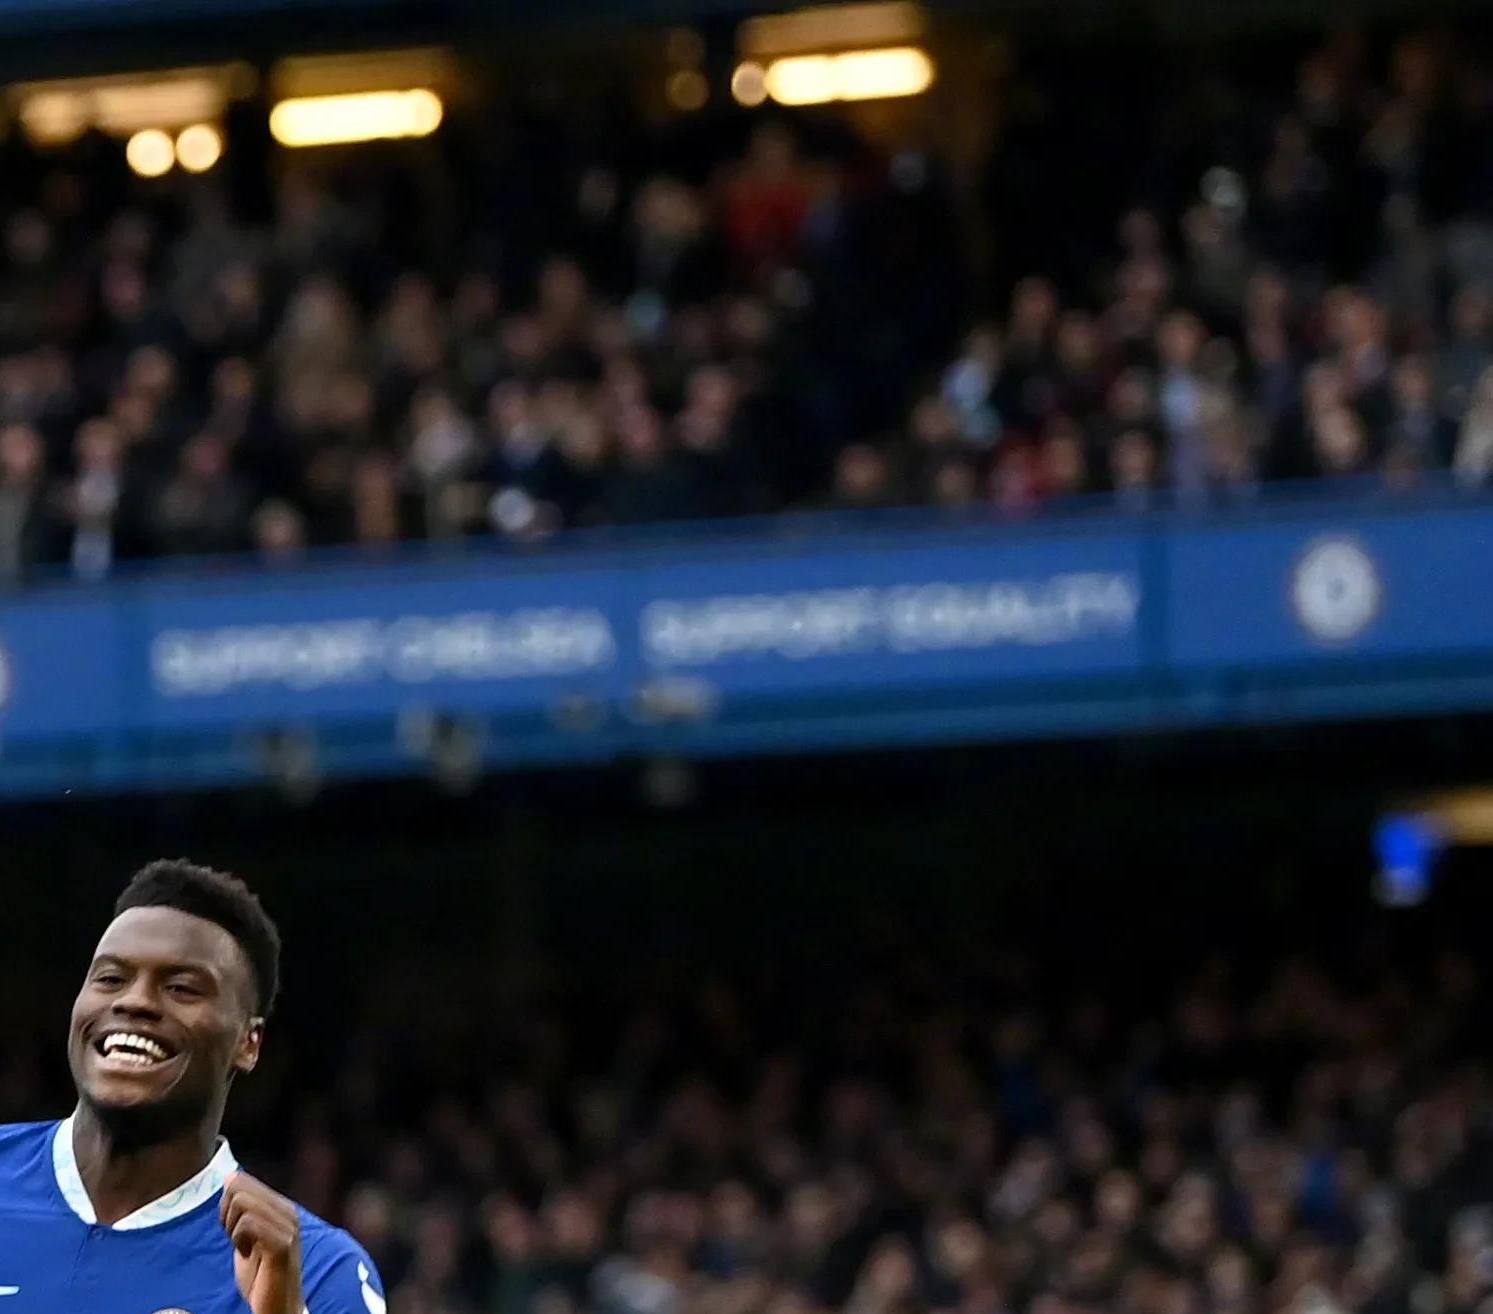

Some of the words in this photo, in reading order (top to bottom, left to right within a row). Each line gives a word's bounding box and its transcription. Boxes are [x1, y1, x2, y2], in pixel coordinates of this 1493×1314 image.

[152, 617, 382, 698] SUPPORT
[387, 606, 613, 682] CHELSEA
[641, 589, 873, 668] SUPPORT
[879, 572, 1137, 655] EQUALITY
